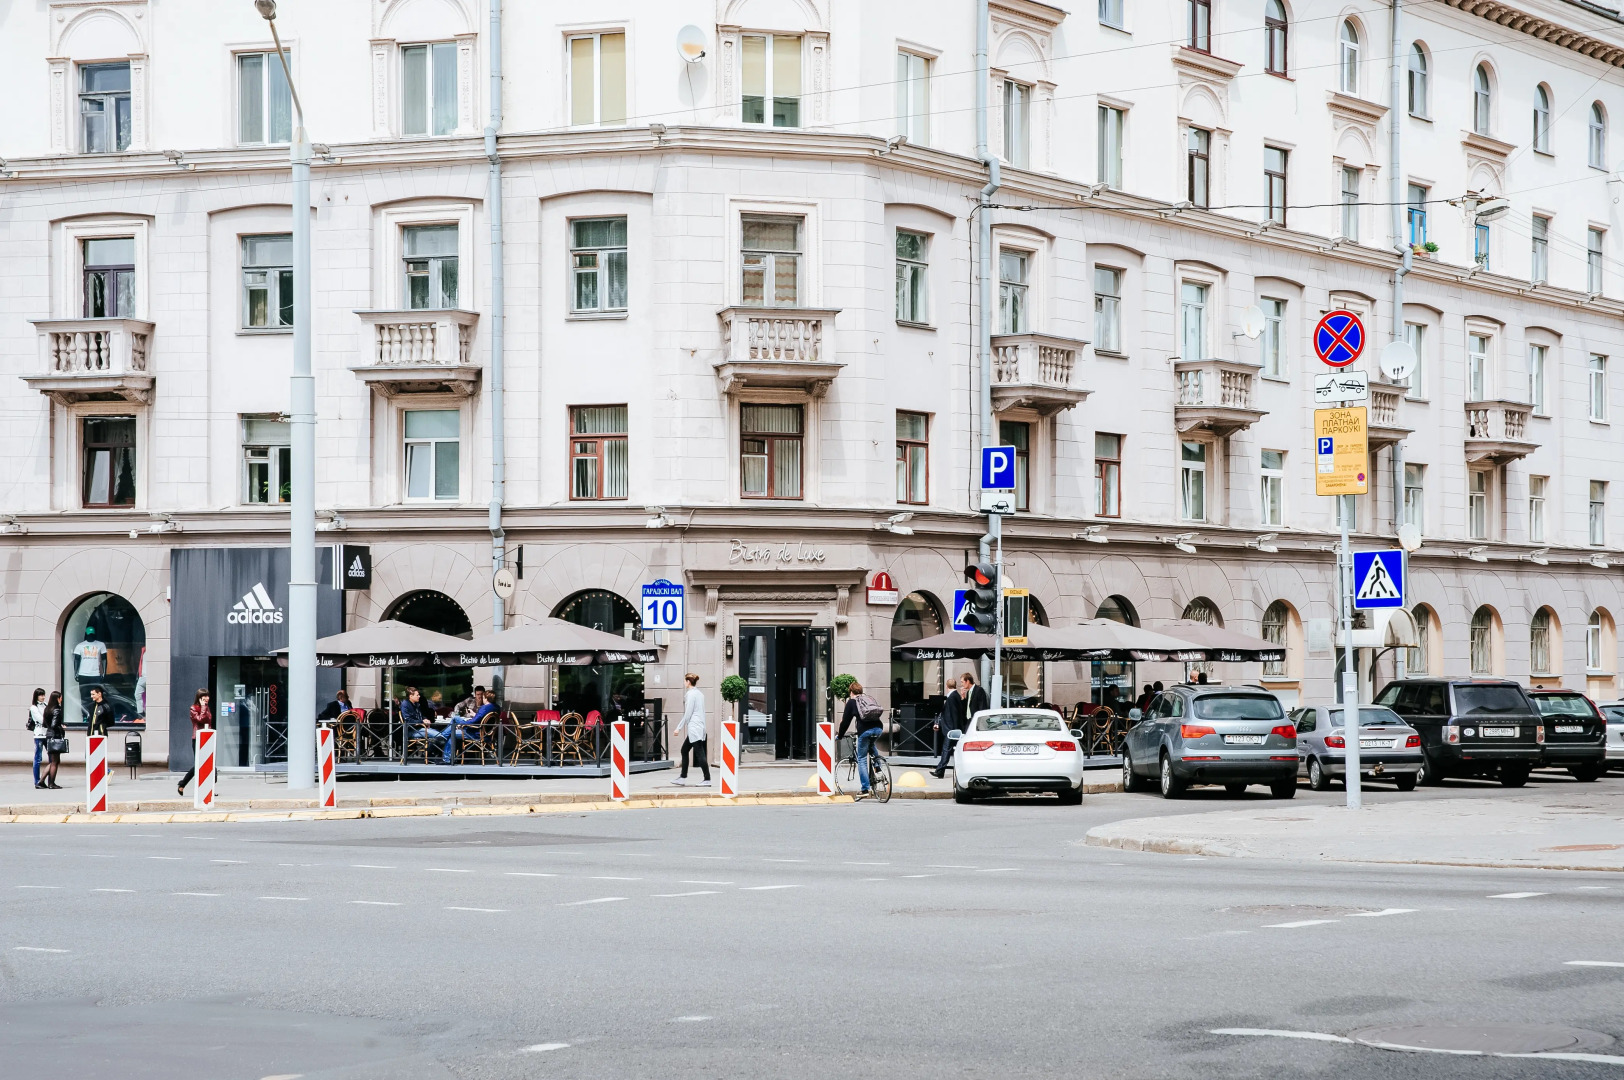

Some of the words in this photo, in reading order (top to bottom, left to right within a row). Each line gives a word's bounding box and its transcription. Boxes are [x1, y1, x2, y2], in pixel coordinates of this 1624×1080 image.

[1330, 411, 1351, 420] ЗОНА
[1323, 417, 1360, 428] ПЛАТНАЙ
[1321, 439, 1331, 454] P
[990, 451, 1008, 484] P
[729, 538, 771, 564] Bistro
[777, 542, 792, 562] de
[797, 541, 826, 563] Luxe
[348, 569, 366, 578] adidas
[881, 574, 887, 590] 1
[642, 587, 670, 595] ГАРАДСКІ
[670, 587, 683, 595] ВАЛ
[227, 608, 284, 624] adidas
[647, 599, 678, 626] 10
[460, 653, 478, 664] Bistro
[536, 653, 555, 664] Bistro
